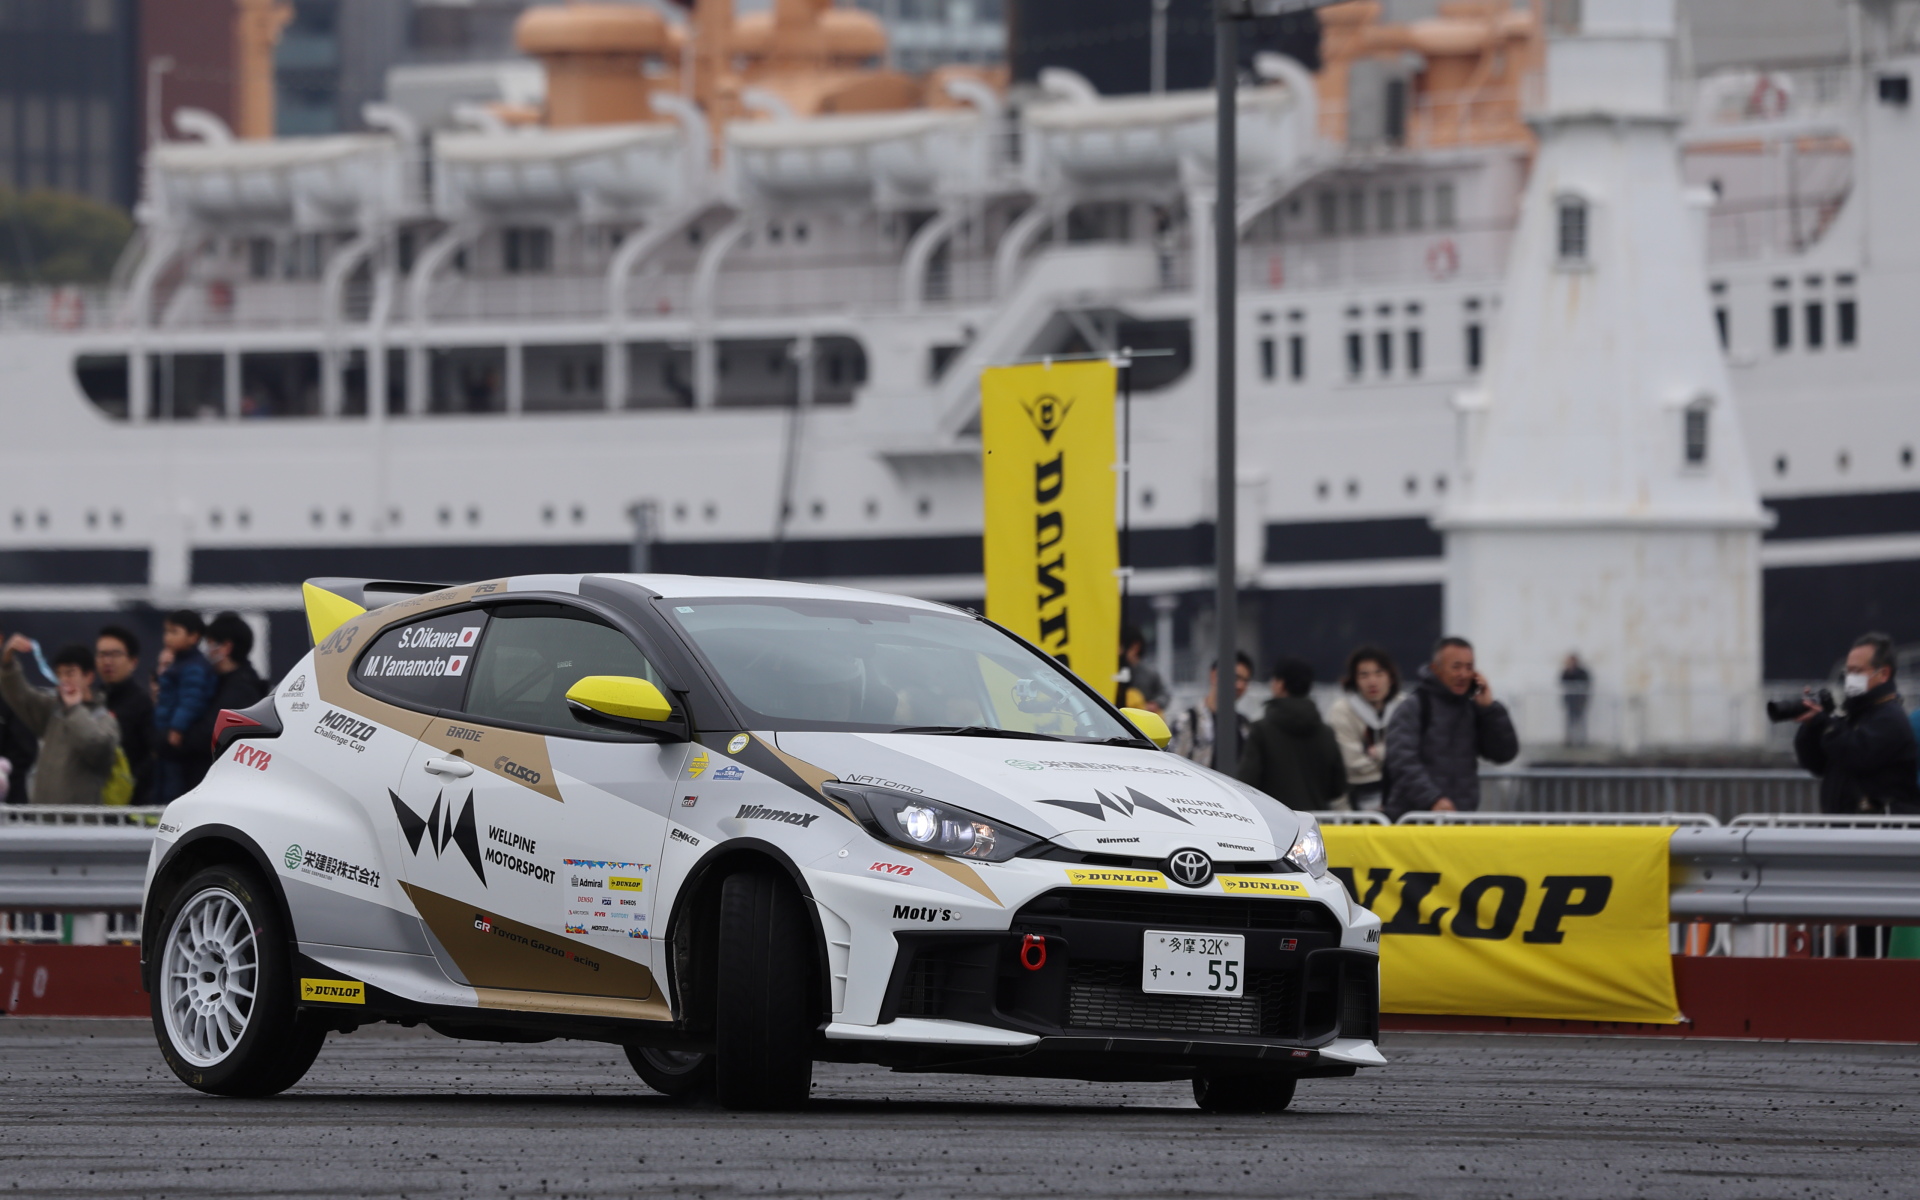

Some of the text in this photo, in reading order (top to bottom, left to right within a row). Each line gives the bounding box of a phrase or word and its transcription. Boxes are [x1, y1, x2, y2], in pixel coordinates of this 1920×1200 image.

[398, 627, 458, 648] S.Oikawa
[364, 656, 446, 677] M.Yamamoto
[319, 710, 377, 742] MORIZO
[446, 726, 484, 742] BRIDE
[314, 726, 366, 753] Challenge Cup
[233, 743, 272, 771] KYB
[504, 762, 541, 784] CUSCO
[1166, 797, 1225, 809] WELLPINE
[1177, 806, 1255, 825] MOTORSPORT
[489, 825, 536, 854] WELLPINE
[671, 828, 700, 846] ENKEI
[302, 850, 381, 888] 栄建設株式会社
[485, 847, 555, 884] MOTORSPORT
[868, 862, 914, 876] KYB
[579, 878, 603, 888] Admiral
[1089, 873, 1159, 883] DUNLOP
[1238, 881, 1300, 891] DUNLOP
[893, 904, 952, 922] Moty's
[474, 920, 490, 933] GR
[1169, 937, 1223, 955] 多摩 32K
[565, 951, 600, 972] Racing
[1150, 964, 1161, 980] す
[1208, 960, 1238, 991] 55
[314, 986, 360, 997] DUNLOP
